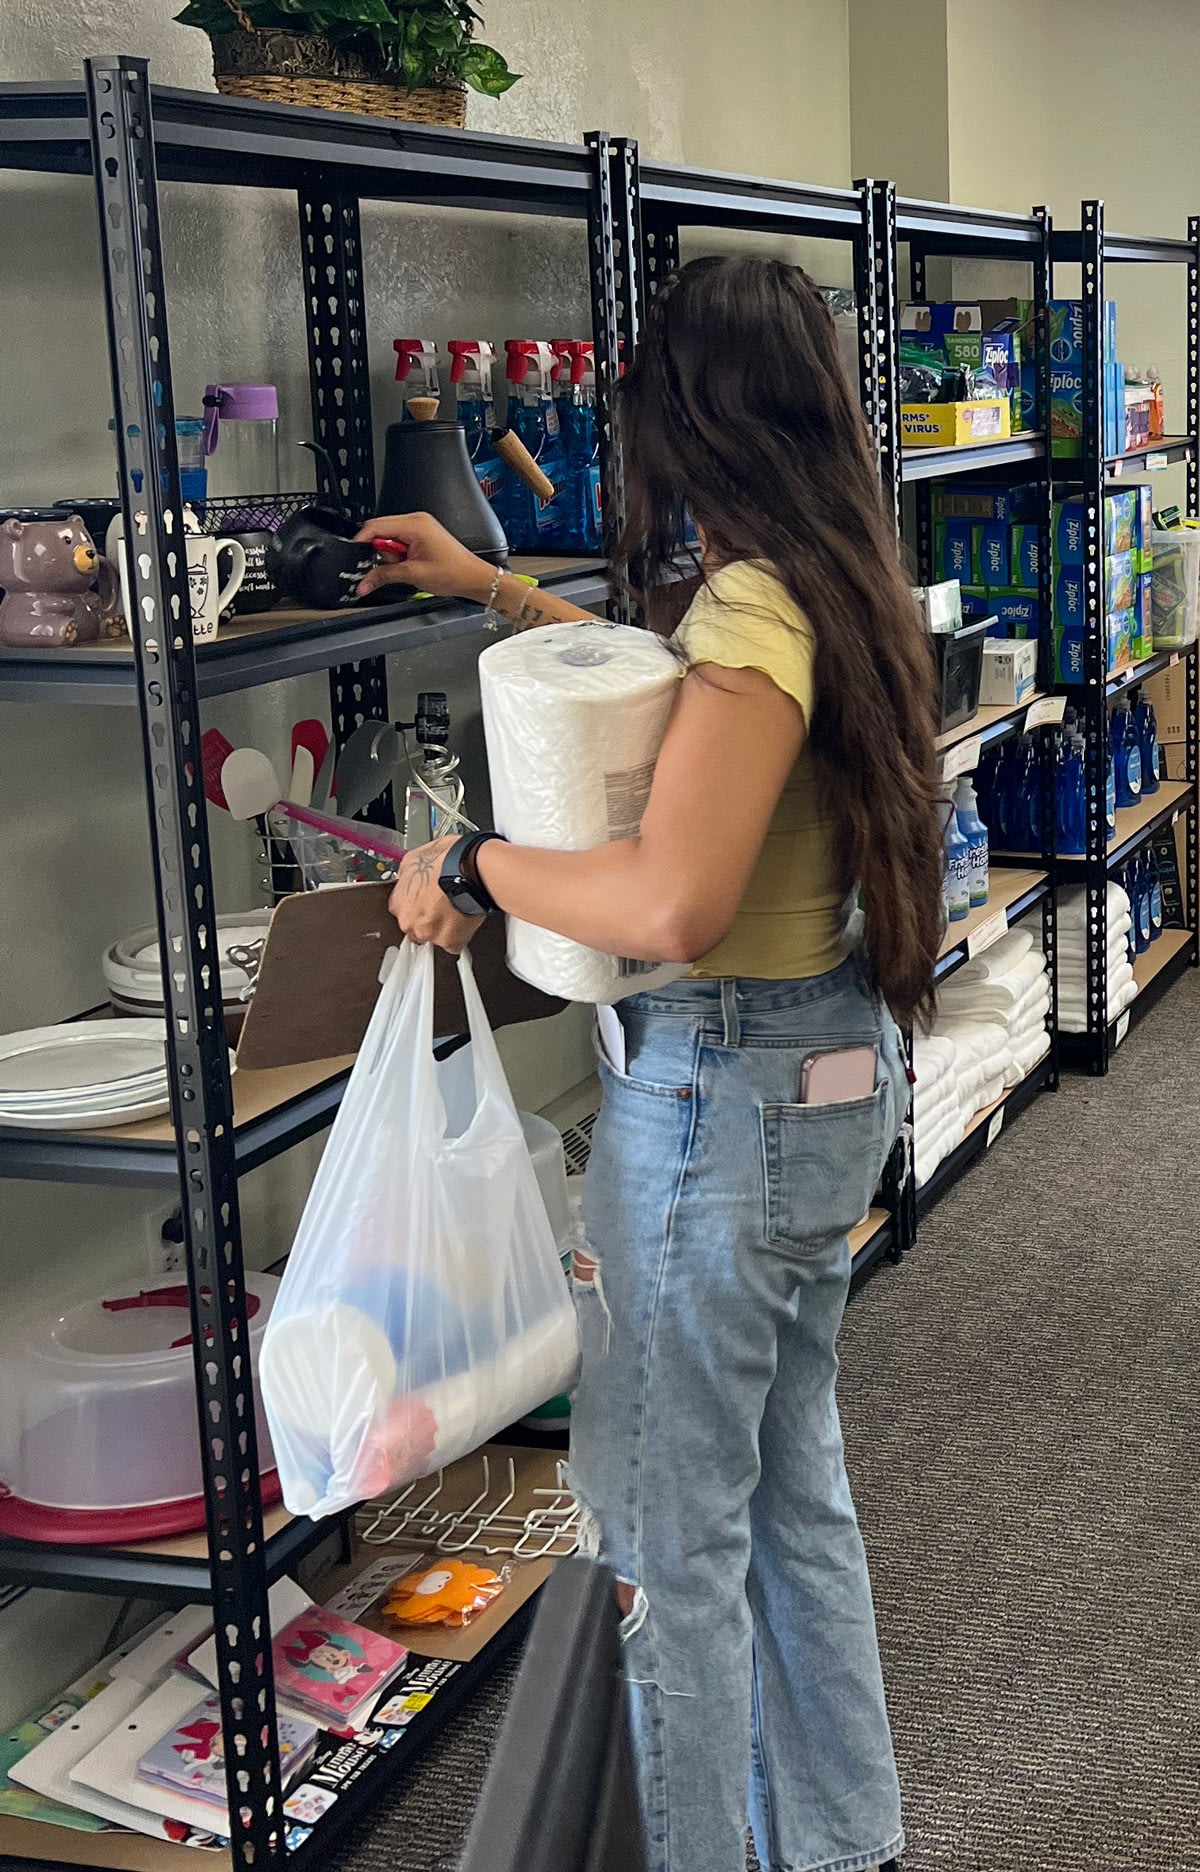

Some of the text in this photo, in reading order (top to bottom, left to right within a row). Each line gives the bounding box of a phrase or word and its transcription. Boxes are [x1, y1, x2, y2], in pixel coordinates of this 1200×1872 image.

[954, 345, 979, 358] 580
[985, 346, 1009, 364] Ziploc
[1050, 373, 1083, 393] iploc
[902, 413, 930, 422] RMS
[904, 424, 940, 433] VIRUS
[995, 496, 1006, 520] Ziploc
[1066, 521, 1079, 551] Ziploc
[951, 541, 963, 570] Ziploc
[987, 542, 1000, 572] Ziploc
[1027, 544, 1039, 573] Ziploc
[1001, 604, 1030, 617] Ziploc
[1065, 583, 1078, 612] Ziploc
[193, 622, 213, 635] tte
[1068, 643, 1081, 672] Ziploc
[400, 1660, 442, 1692] Minnie
[309, 1742, 357, 1788] Minnie
